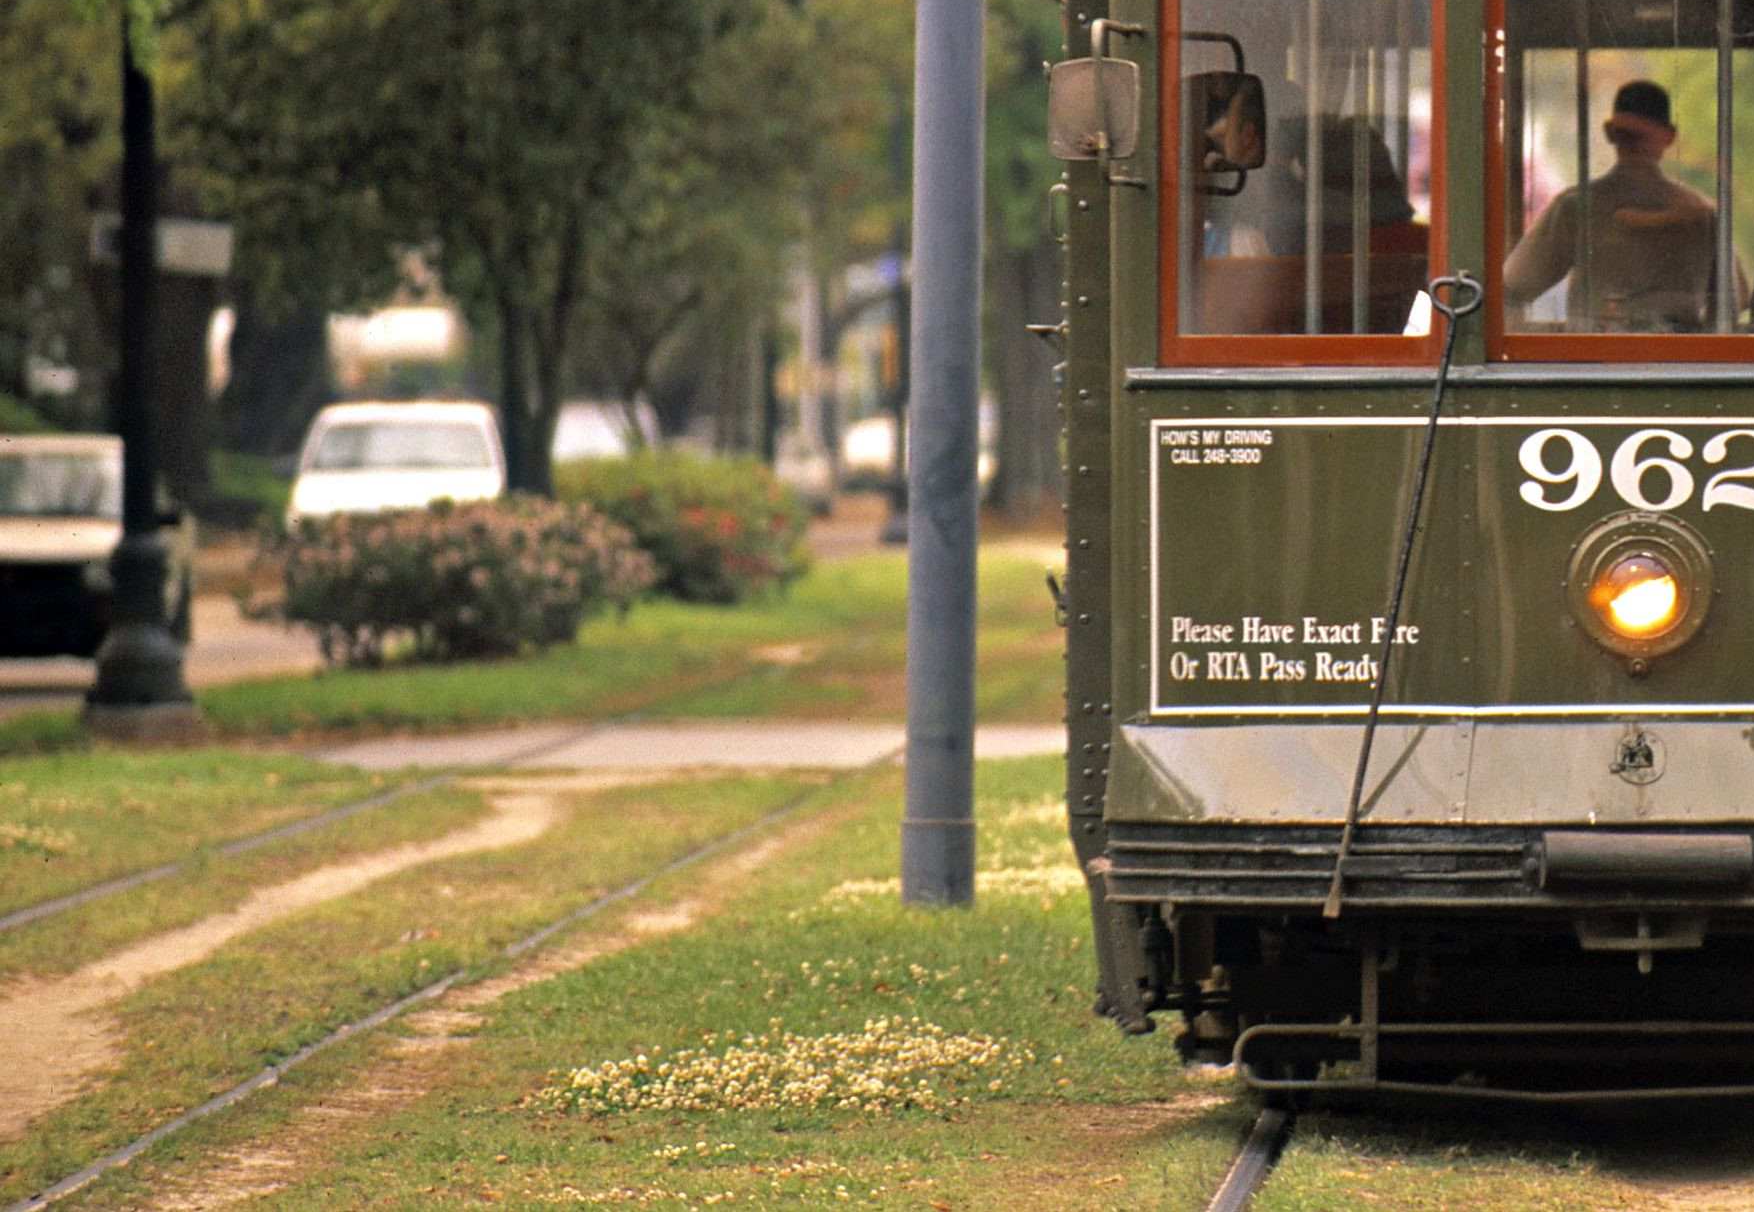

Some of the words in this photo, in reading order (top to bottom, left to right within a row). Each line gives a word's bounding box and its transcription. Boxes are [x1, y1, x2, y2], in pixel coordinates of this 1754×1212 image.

[1160, 430, 1200, 446] HOW'S
[1202, 430, 1221, 445] MY
[1224, 429, 1273, 445] DRIVING
[1171, 448, 1201, 464] CALL
[1171, 616, 1235, 643] Please
[1242, 616, 1296, 644] Have
[1302, 616, 1362, 644] Exact
[1371, 616, 1420, 644] Fre
[1170, 651, 1200, 681] Or
[1206, 651, 1251, 681] RTA
[1258, 651, 1307, 681] Pass
